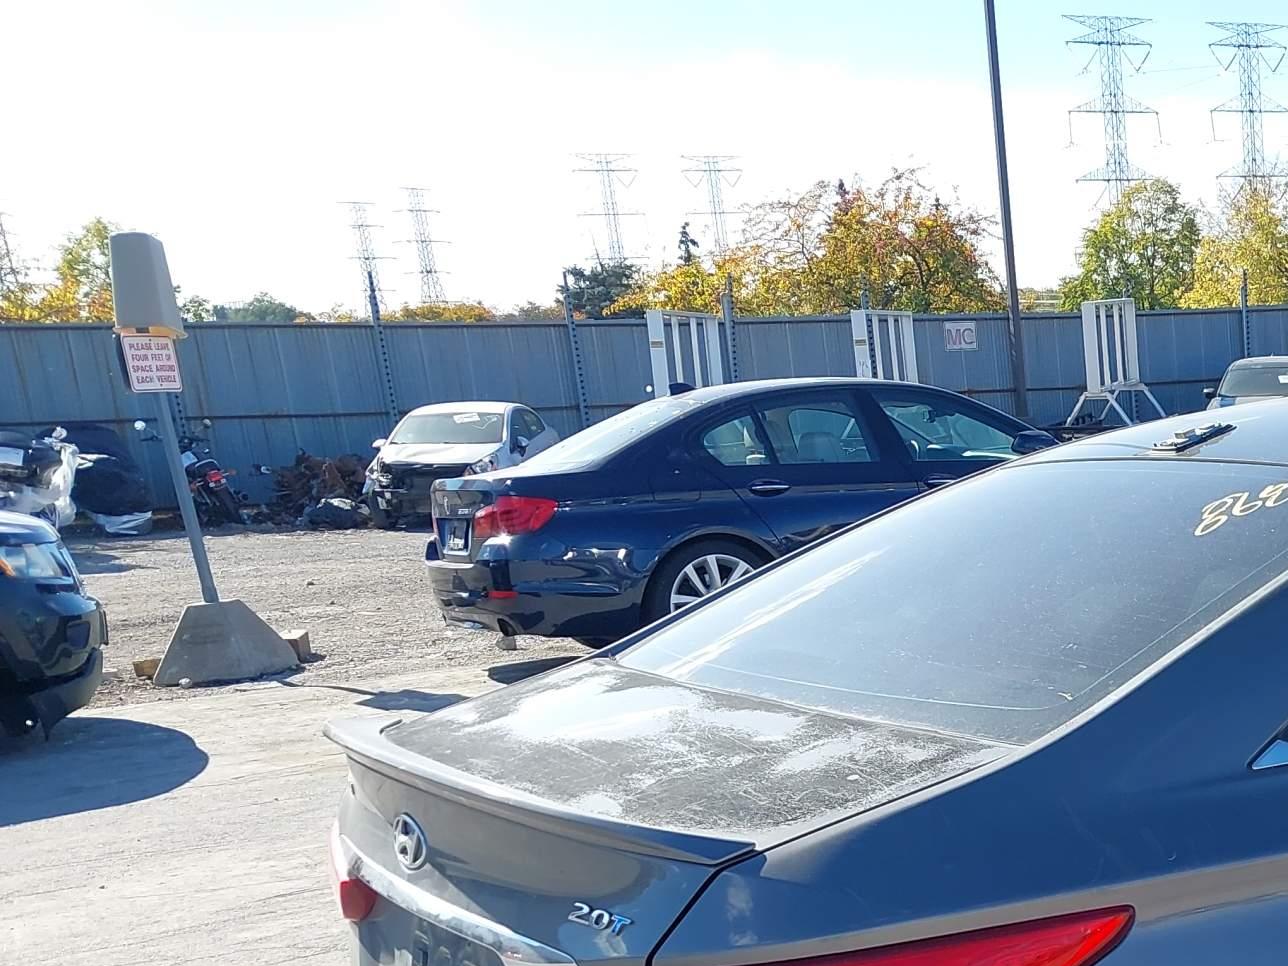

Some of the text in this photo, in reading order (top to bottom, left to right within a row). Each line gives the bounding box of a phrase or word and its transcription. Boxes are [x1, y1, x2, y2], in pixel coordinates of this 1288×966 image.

[128, 342, 154, 351] PLEASE
[131, 353, 150, 362] FOUR
[151, 353, 164, 362] FEET
[131, 364, 154, 373] SPACE
[136, 374, 177, 384] EACH VEHICLE
